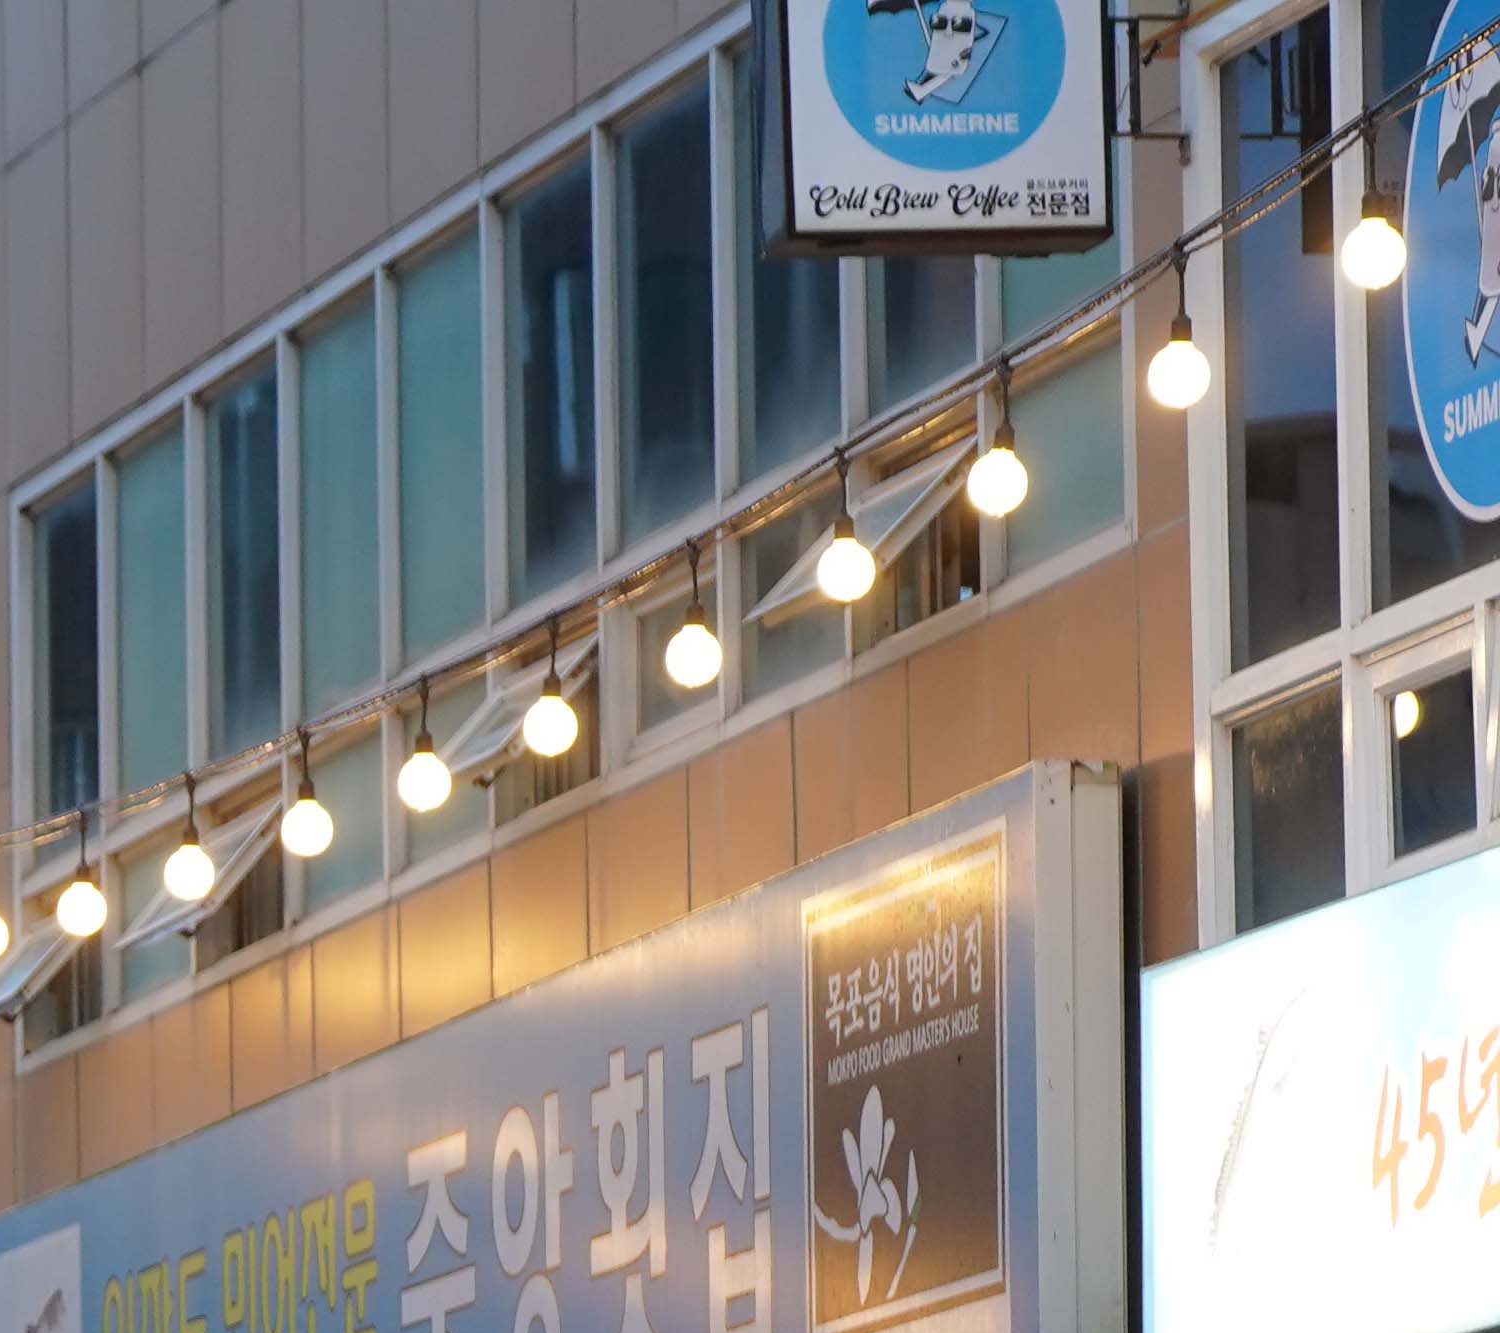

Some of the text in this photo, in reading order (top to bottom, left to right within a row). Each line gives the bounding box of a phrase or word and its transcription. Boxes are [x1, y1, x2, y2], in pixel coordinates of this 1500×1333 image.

[875, 112, 1020, 136] SUMMERNE
[809, 183, 1019, 217] Cold Brew Coffee
[1026, 191, 1090, 217] 전문점
[825, 912, 982, 1047] 목포음식 명인의 집
[828, 1052, 859, 1085] MOKPO
[858, 1046, 882, 1074] FOOD
[882, 1032, 911, 1065] GRAND
[951, 1003, 979, 1039] HOUSE
